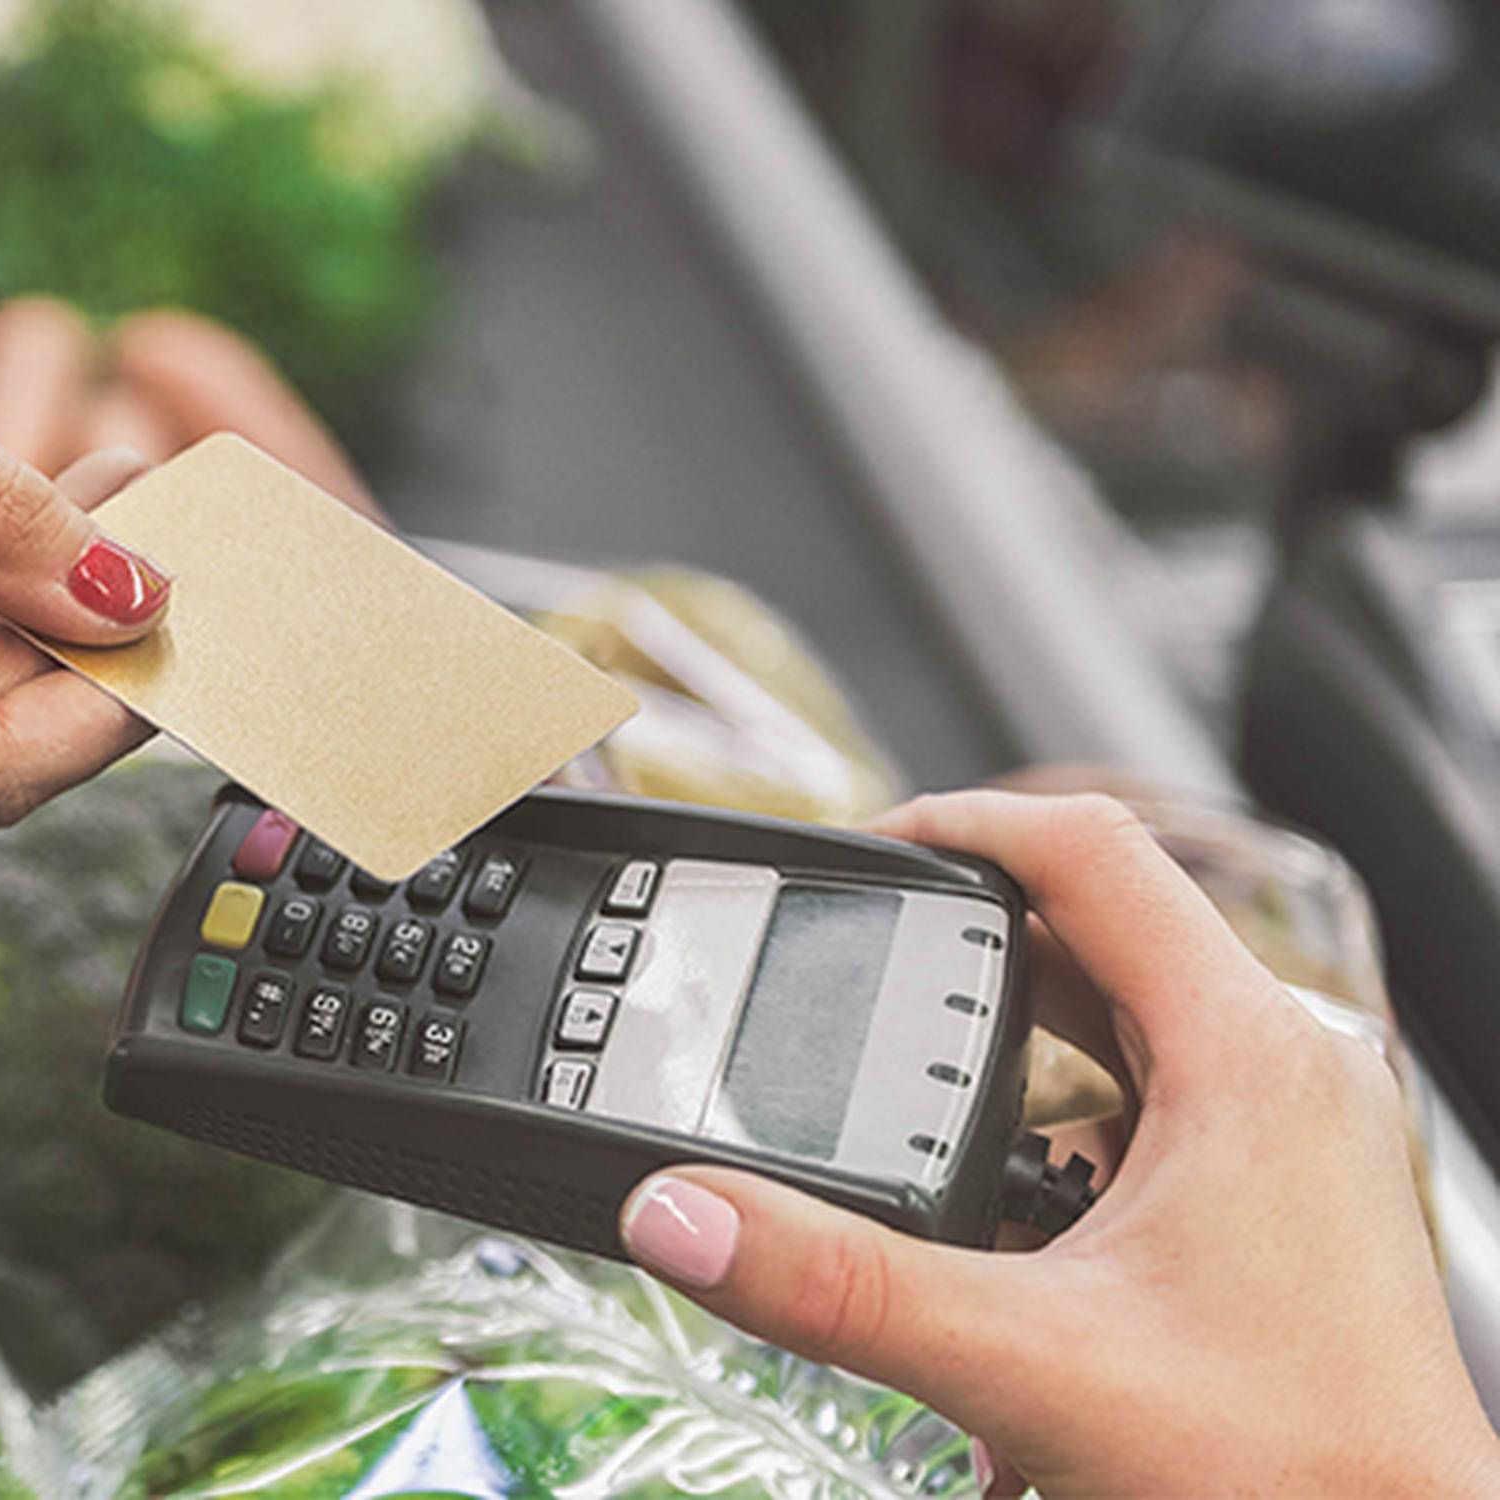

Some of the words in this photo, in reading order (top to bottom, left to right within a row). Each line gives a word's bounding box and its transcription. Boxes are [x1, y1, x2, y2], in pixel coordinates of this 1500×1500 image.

[485, 860, 515, 874] 1
[283, 900, 312, 921] 0
[340, 912, 370, 933] 8
[395, 921, 425, 942] 5
[451, 935, 482, 956] 2
[311, 993, 342, 1014] 9
[369, 1007, 399, 1027] 6
[425, 1023, 455, 1044] 3
